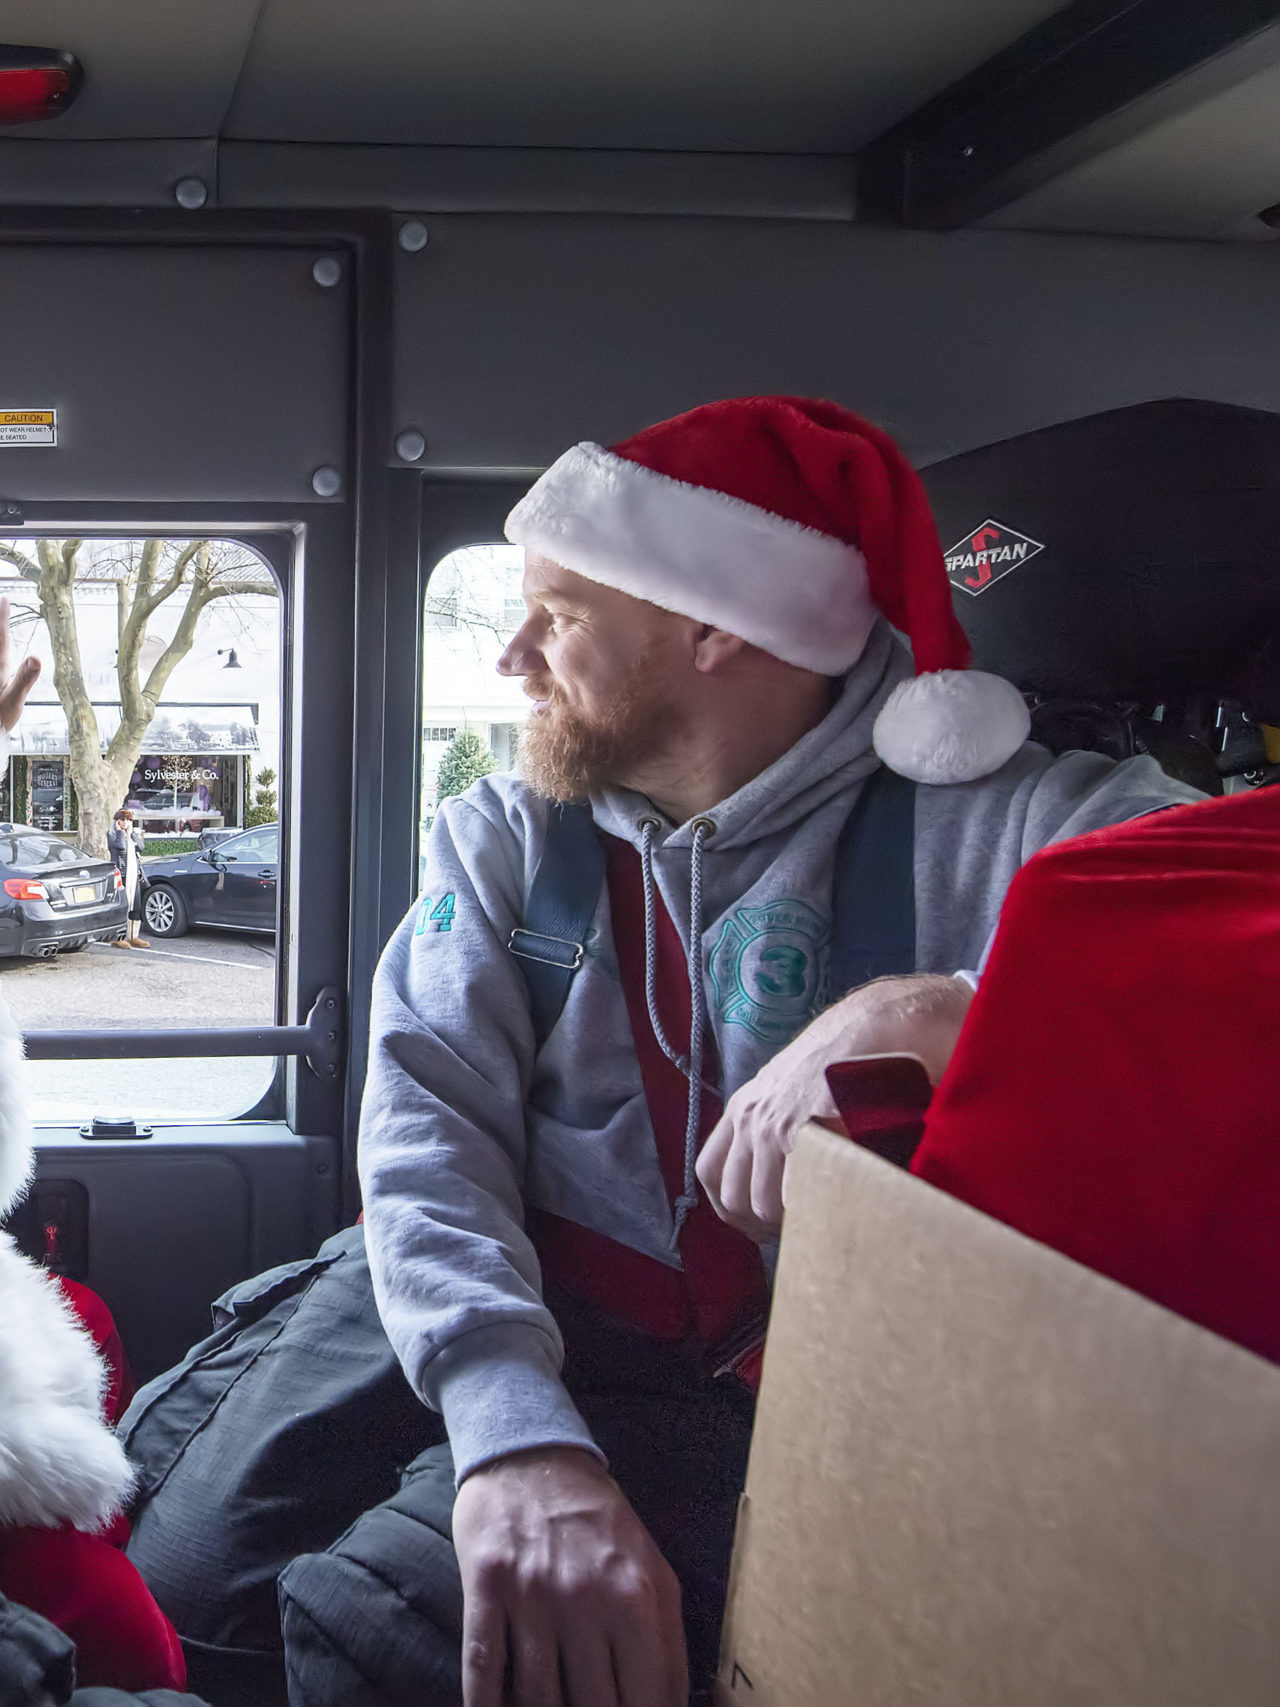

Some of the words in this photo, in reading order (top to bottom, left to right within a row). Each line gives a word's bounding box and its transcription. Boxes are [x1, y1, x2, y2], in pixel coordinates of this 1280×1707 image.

[144, 769, 189, 783] Sylvester
[191, 770, 200, 780] &
[202, 769, 219, 780] Co.
